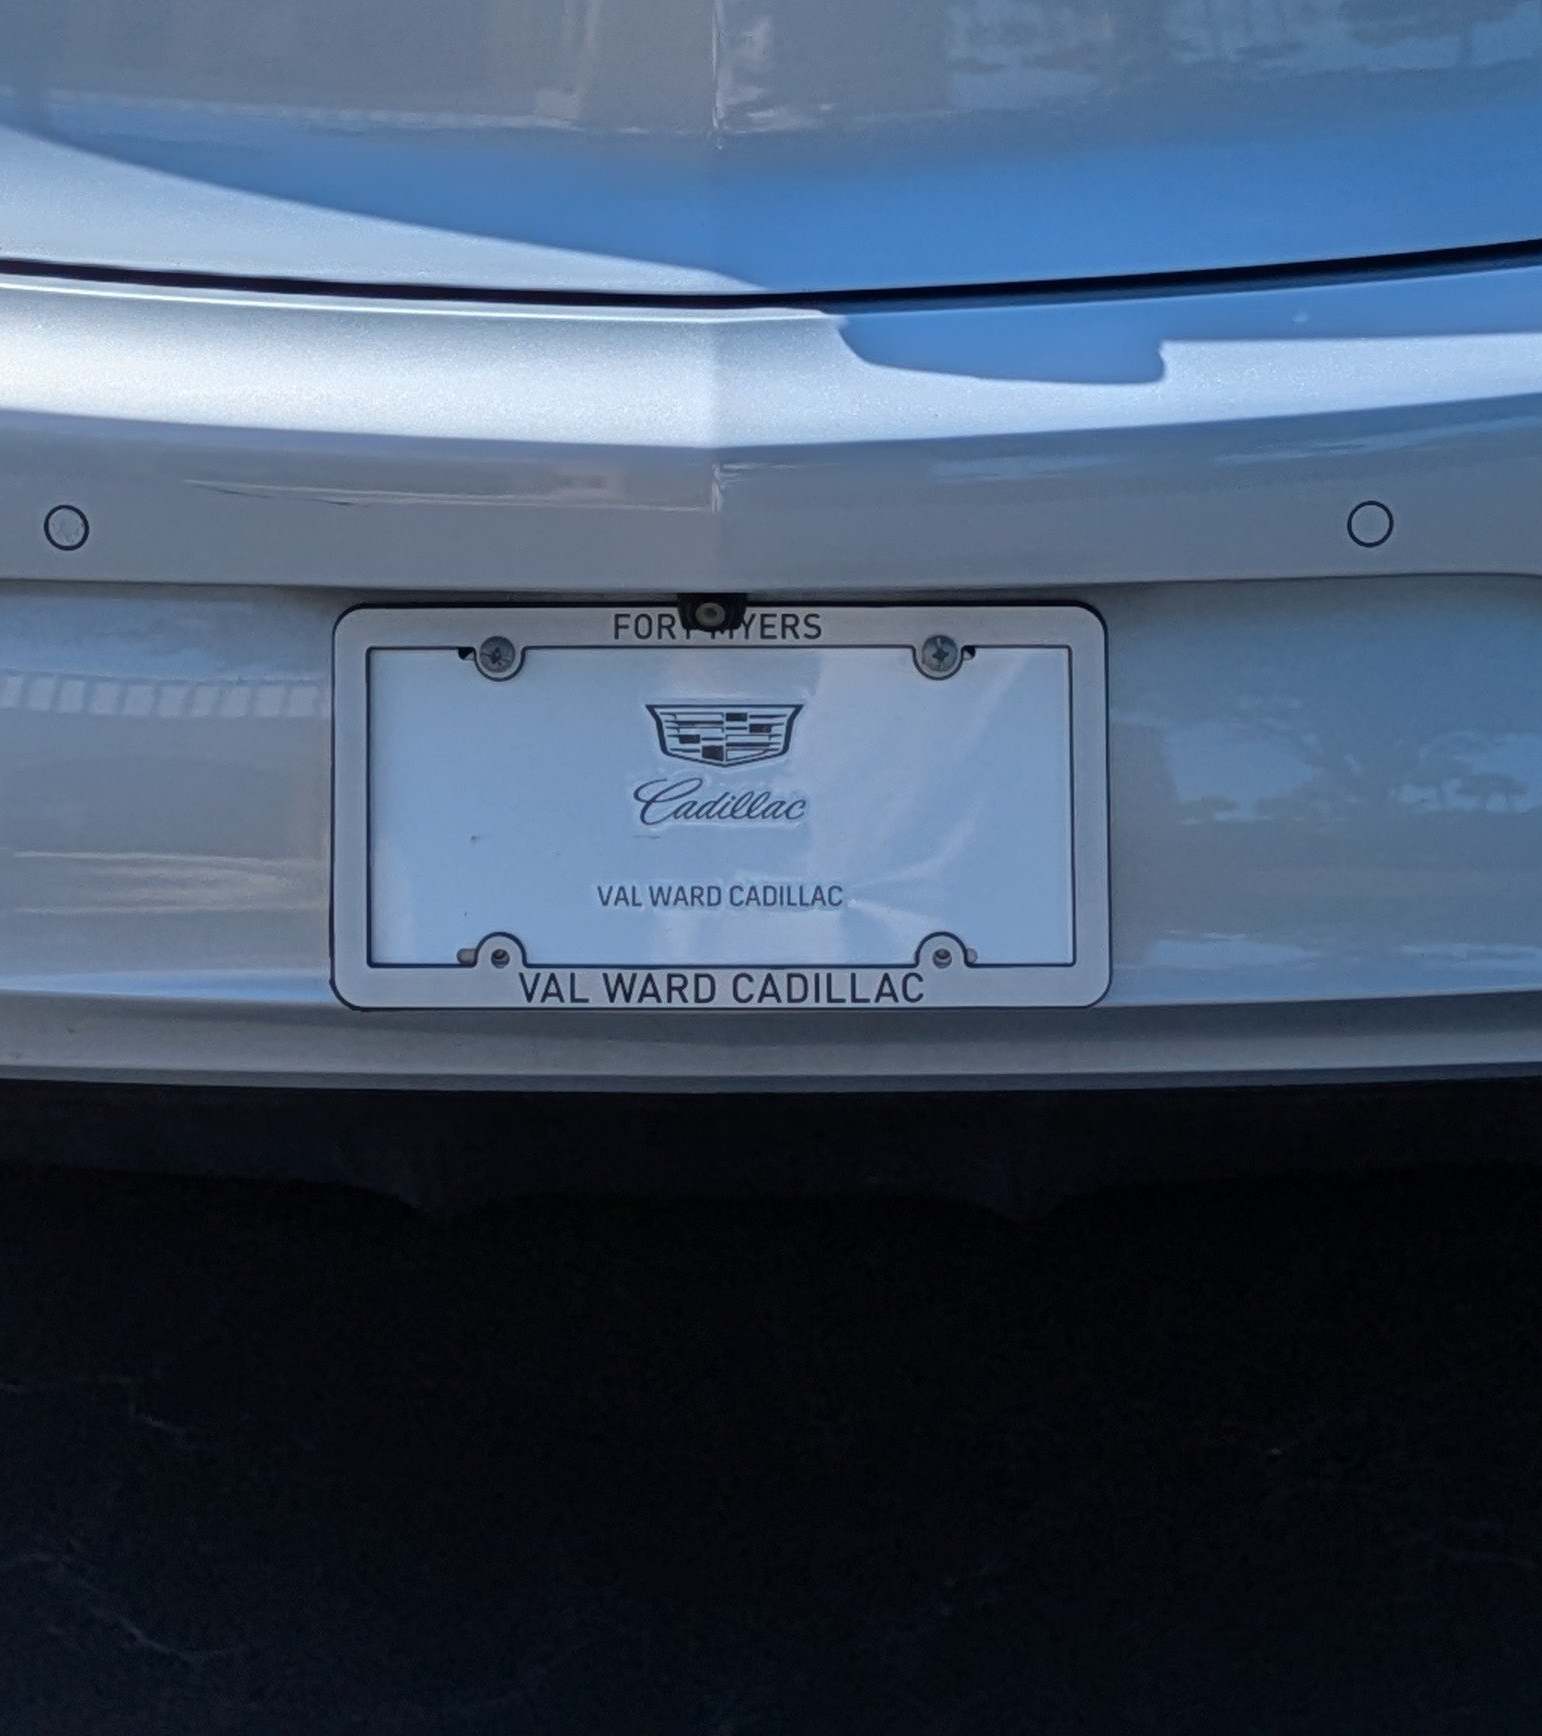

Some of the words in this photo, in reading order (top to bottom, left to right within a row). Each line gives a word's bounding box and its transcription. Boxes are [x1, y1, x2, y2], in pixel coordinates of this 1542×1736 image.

[633, 777, 807, 826] Cadillac
[597, 885, 643, 907] VAL
[648, 885, 722, 907] WARD
[728, 885, 844, 907] CADILLAC
[518, 972, 590, 1004] VAL
[602, 972, 717, 1004] WARD
[731, 972, 926, 1004] CADILLAC
